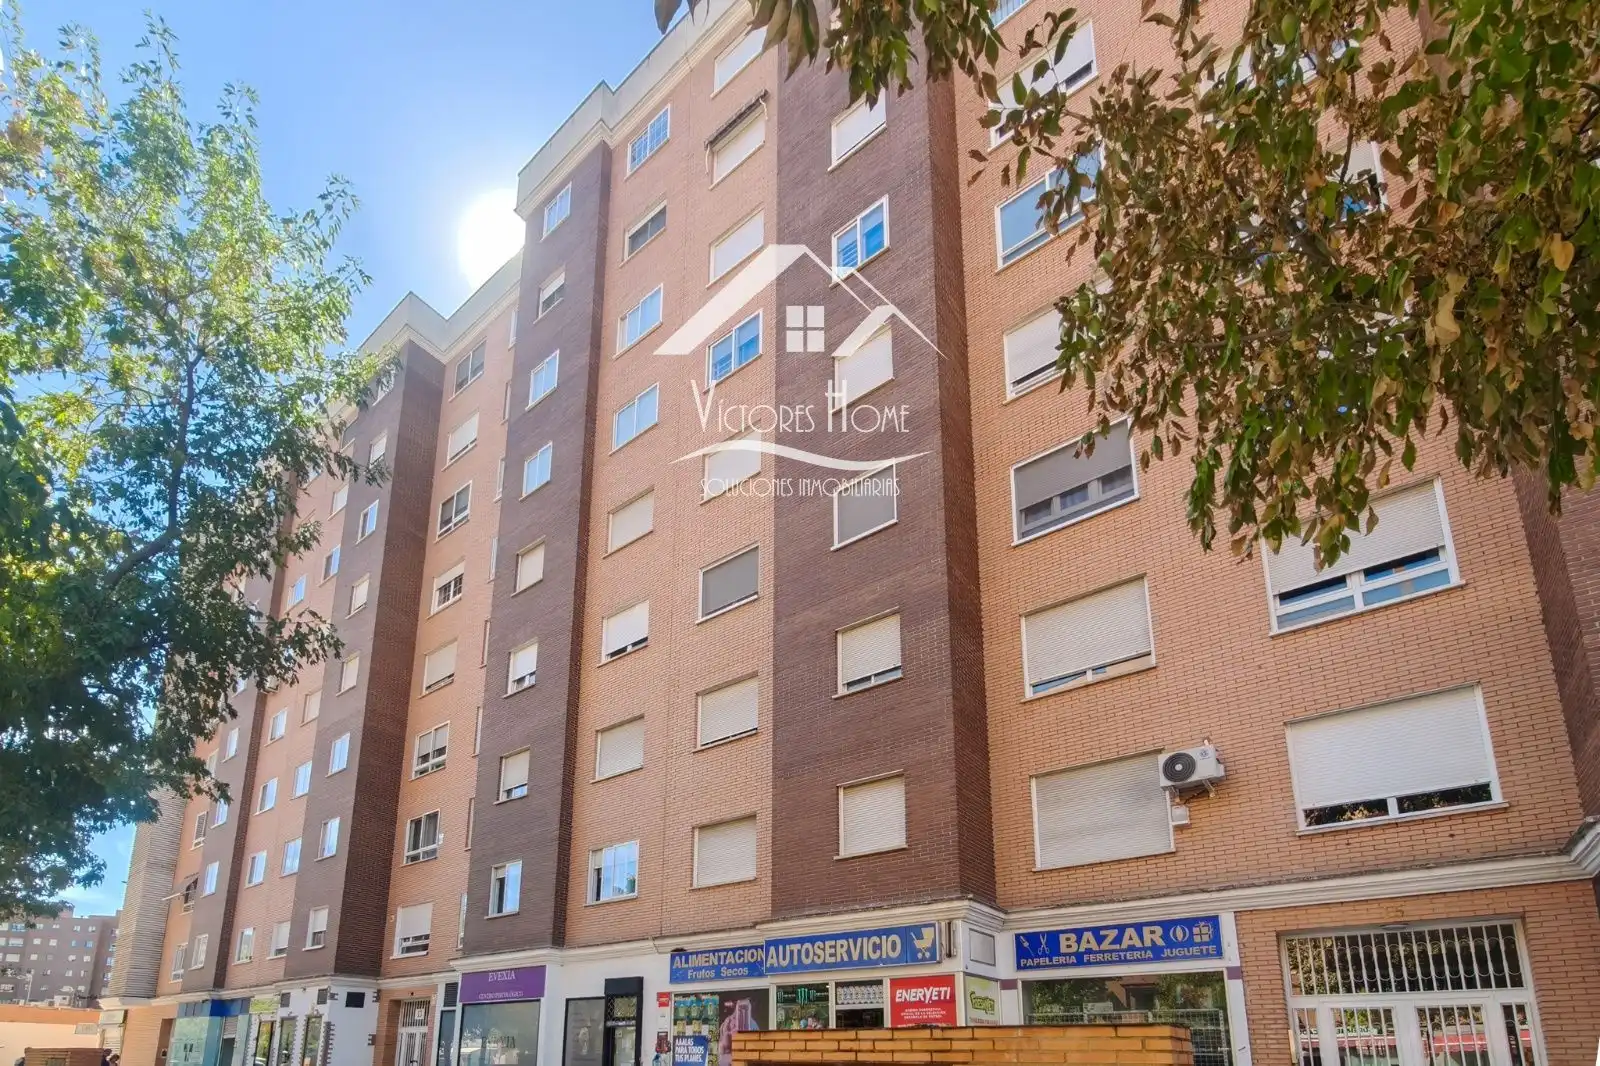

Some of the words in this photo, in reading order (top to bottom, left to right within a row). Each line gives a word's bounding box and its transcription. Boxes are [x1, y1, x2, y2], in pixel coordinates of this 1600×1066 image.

[1059, 925, 1165, 954] BAZAR
[673, 949, 764, 969] ALIMENTACION
[766, 934, 901, 968] AUTOSERVICIO
[1020, 956, 1077, 967] PAPELERIA
[1083, 950, 1153, 963] FERRETERIA
[1161, 945, 1217, 957] JUGUETE
[488, 970, 516, 982] EVEXIA
[687, 969, 715, 979] Frutos
[720, 966, 749, 977] Secos
[895, 986, 951, 1004] ENERYETI
